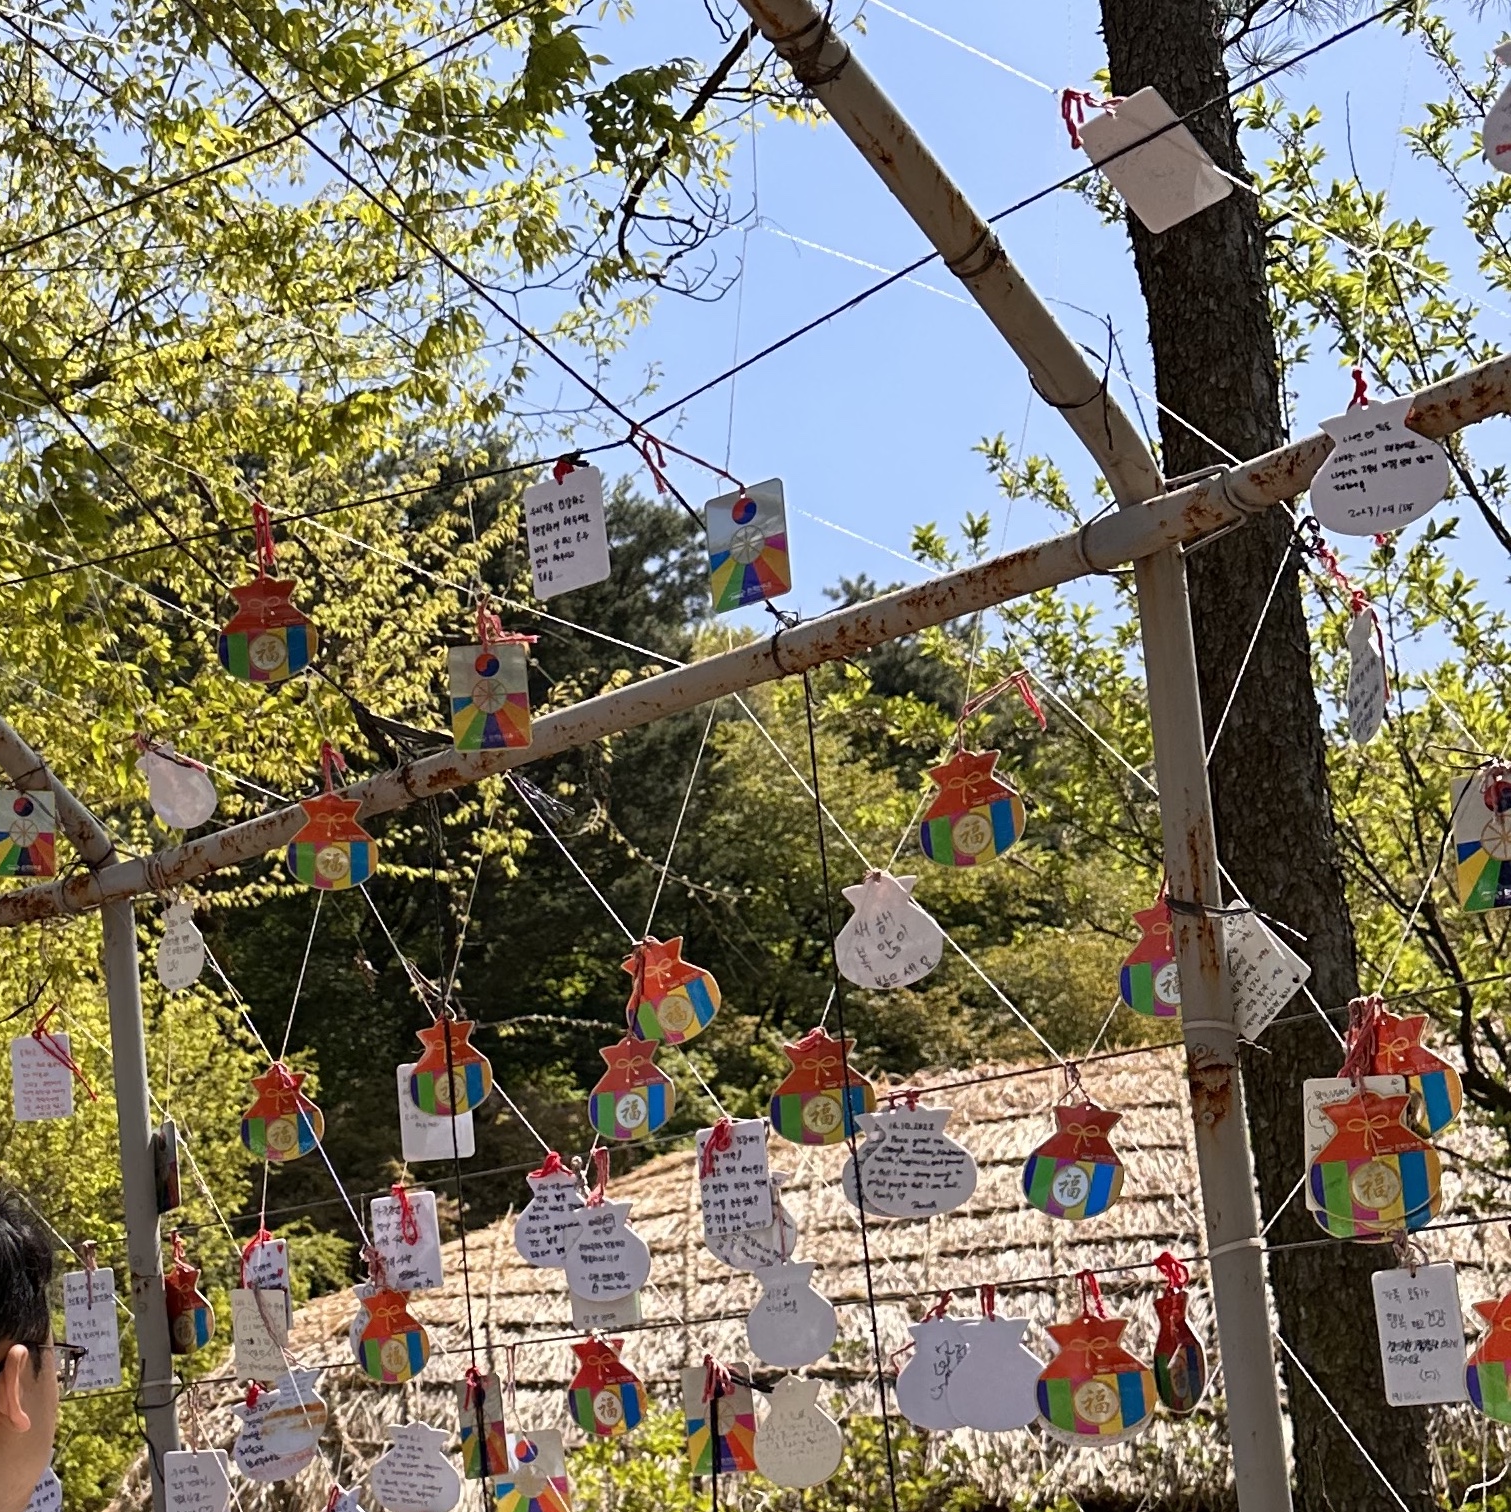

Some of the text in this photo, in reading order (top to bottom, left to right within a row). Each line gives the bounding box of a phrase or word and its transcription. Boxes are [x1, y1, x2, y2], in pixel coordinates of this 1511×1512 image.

[257, 637, 280, 664] 福
[959, 819, 985, 848] 福
[321, 851, 343, 873] 福
[620, 1098, 642, 1120] 福
[808, 1101, 836, 1126] 福
[271, 1123, 295, 1146] 福
[1058, 1170, 1082, 1200] 福
[1359, 1170, 1388, 1201] 福
[385, 1343, 406, 1366] 福
[597, 1395, 617, 1419] 福
[1081, 1387, 1109, 1415] 福
